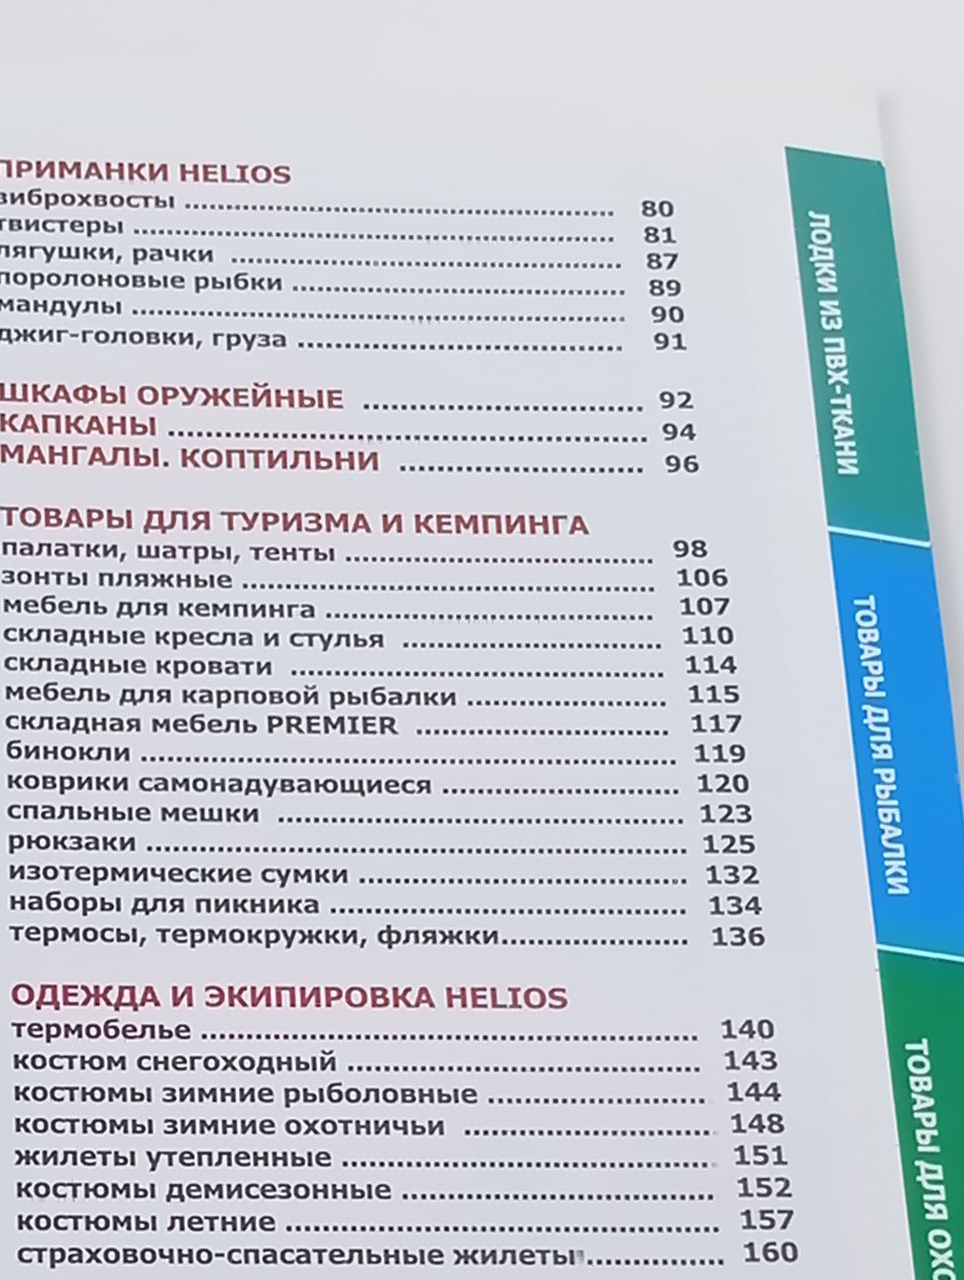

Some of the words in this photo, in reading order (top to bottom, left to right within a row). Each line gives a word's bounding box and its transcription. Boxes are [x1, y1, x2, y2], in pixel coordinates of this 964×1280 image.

[179, 163, 292, 185] HELIOS
[643, 225, 677, 244] 81
[808, 210, 839, 293] ЛОДКИ
[194, 271, 283, 295] рыбки
[648, 278, 682, 298] 89
[819, 300, 843, 331] ИЗ
[212, 332, 287, 352] груза
[653, 331, 688, 351] 91
[137, 385, 345, 410] ОРУЖЕЙНЫЕ
[658, 390, 695, 410] 92
[823, 337, 860, 475] ПВХ-ТКАНИ
[661, 422, 697, 442] 94
[0, 443, 170, 468] МАНГАЛЫ.
[180, 447, 379, 472] КОПТИЛЬНИ
[664, 454, 700, 474] 96
[142, 509, 212, 535] ДЛЯ
[218, 510, 373, 534] ТУРИЗМА
[381, 513, 403, 534] И
[414, 513, 590, 536] КЕМПИНГА
[0, 569, 89, 587] зонты
[98, 571, 233, 589] пляжные
[676, 567, 729, 588] 106
[853, 595, 886, 698] ТОВАРЫ
[3, 655, 147, 677] складные
[155, 659, 273, 680] кровати
[684, 654, 738, 675] 114
[5, 681, 111, 703] мебель
[118, 688, 172, 707] для
[181, 684, 320, 710] карповой
[329, 685, 457, 711] рыбалки
[688, 684, 740, 704] 115
[861, 704, 893, 760] ДЛЯ
[6, 773, 129, 796] коврики
[138, 776, 432, 799] самонадувающиеся
[696, 773, 750, 794] 120
[8, 834, 136, 855] рюкзаки
[702, 834, 756, 855] 125
[872, 767, 910, 895] РЫБАЛКИ
[9, 864, 253, 887] изотермические
[260, 867, 349, 889] сумки
[705, 864, 760, 885] 132
[10, 983, 162, 1013] ОДЕЖДА
[171, 985, 194, 1008] И
[204, 984, 436, 1009] ЭКИПИРОВКА
[445, 986, 569, 1010] HELIOS
[10, 1017, 192, 1044] термобелье
[720, 1018, 775, 1040] 140
[13, 1085, 153, 1104] костюмы
[161, 1086, 275, 1104] зимние
[283, 1081, 479, 1109] рыболовные
[726, 1081, 783, 1103] 144
[904, 1038, 941, 1153] ТОВАРЫ
[14, 1149, 137, 1167] жилеты
[145, 1150, 333, 1173] утепленные
[733, 1144, 789, 1166] 151
[914, 1160, 949, 1221] ДЛЯ
[16, 1213, 158, 1232] костюмы
[166, 1215, 276, 1233] летние
[739, 1208, 795, 1231] 157
